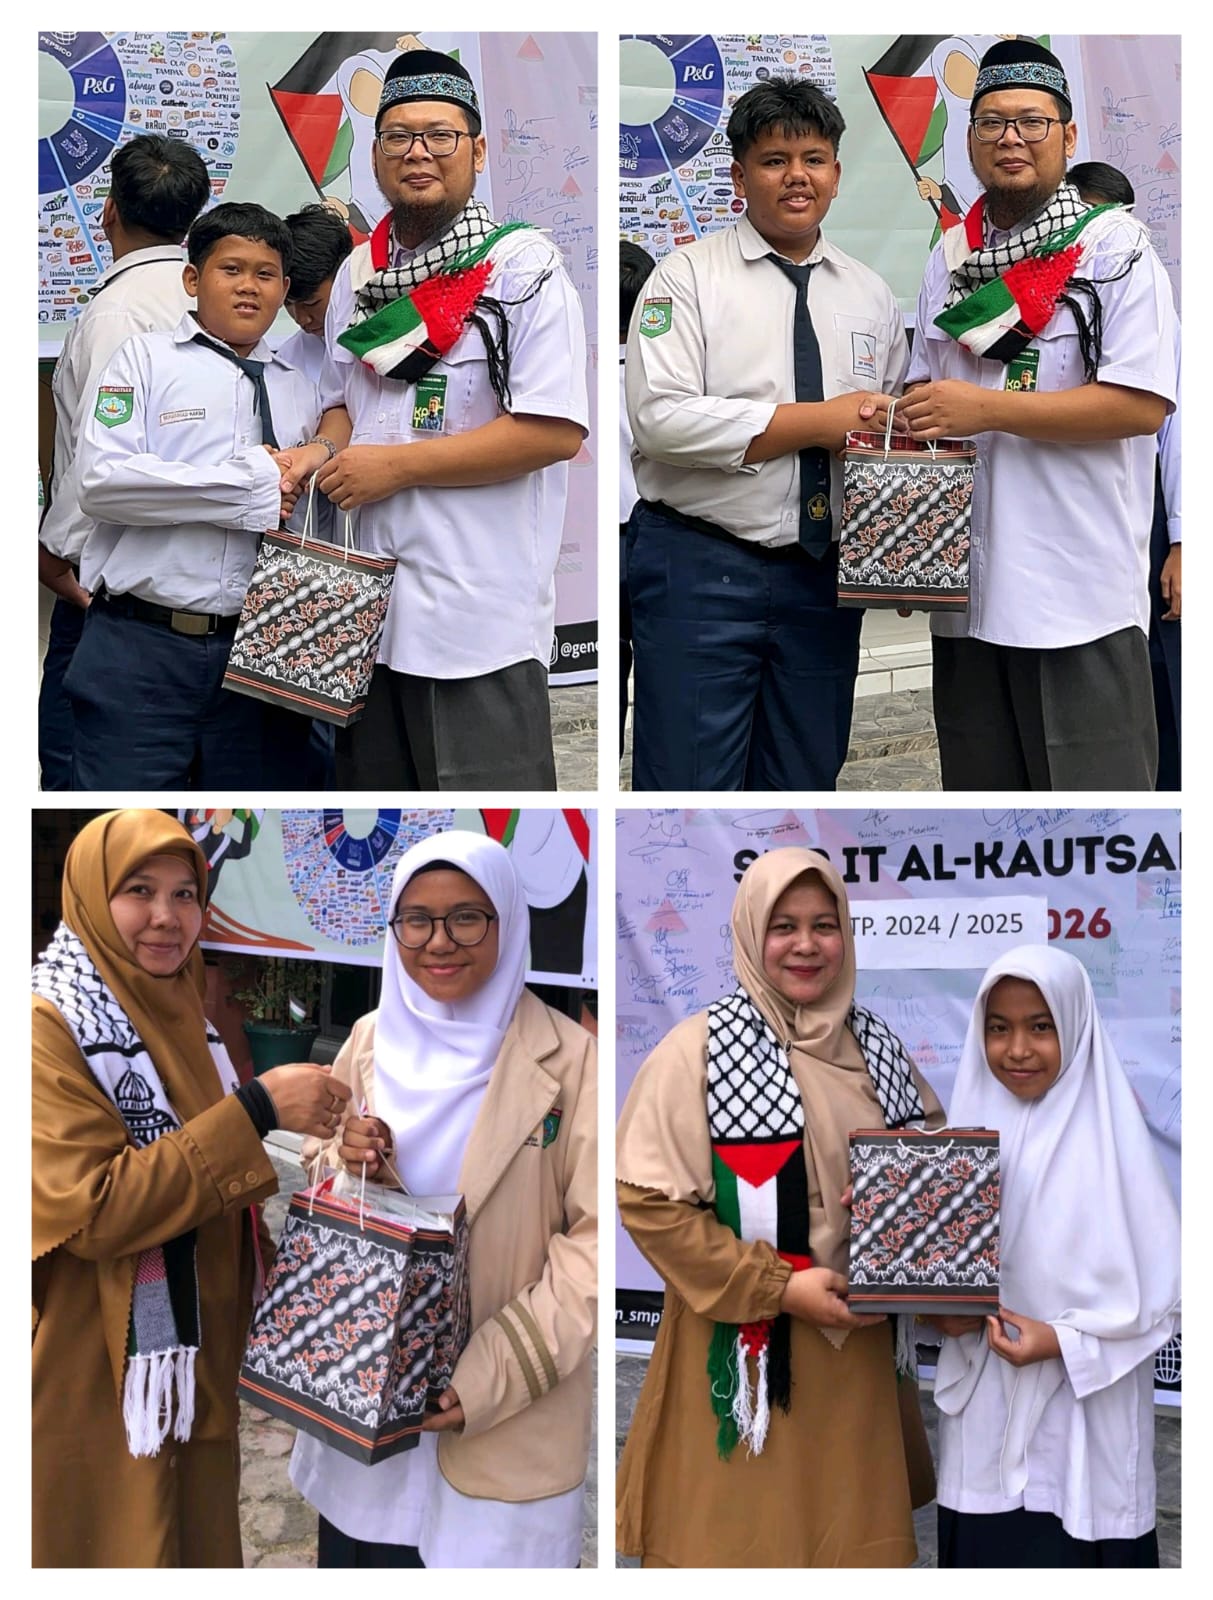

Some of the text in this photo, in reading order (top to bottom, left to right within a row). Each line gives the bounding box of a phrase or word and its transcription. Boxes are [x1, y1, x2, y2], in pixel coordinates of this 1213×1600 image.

[40, 36, 72, 57] PEPSICO
[752, 55, 780, 63] TAMPAX
[155, 67, 183, 77] TAMPAX
[684, 63, 715, 82] P&G
[726, 66, 752, 80] always
[82, 76, 116, 95] P&G
[128, 80, 155, 94] always
[161, 100, 189, 108] Gillette
[205, 91, 230, 103] Downy
[146, 109, 163, 119] FAIRY
[842, 845, 888, 884] IT
[896, 831, 1182, 883] AL-KAUTSA
[885, 914, 942, 937] 2024
[948, 911, 961, 940] /
[966, 912, 1024, 936] 2025
